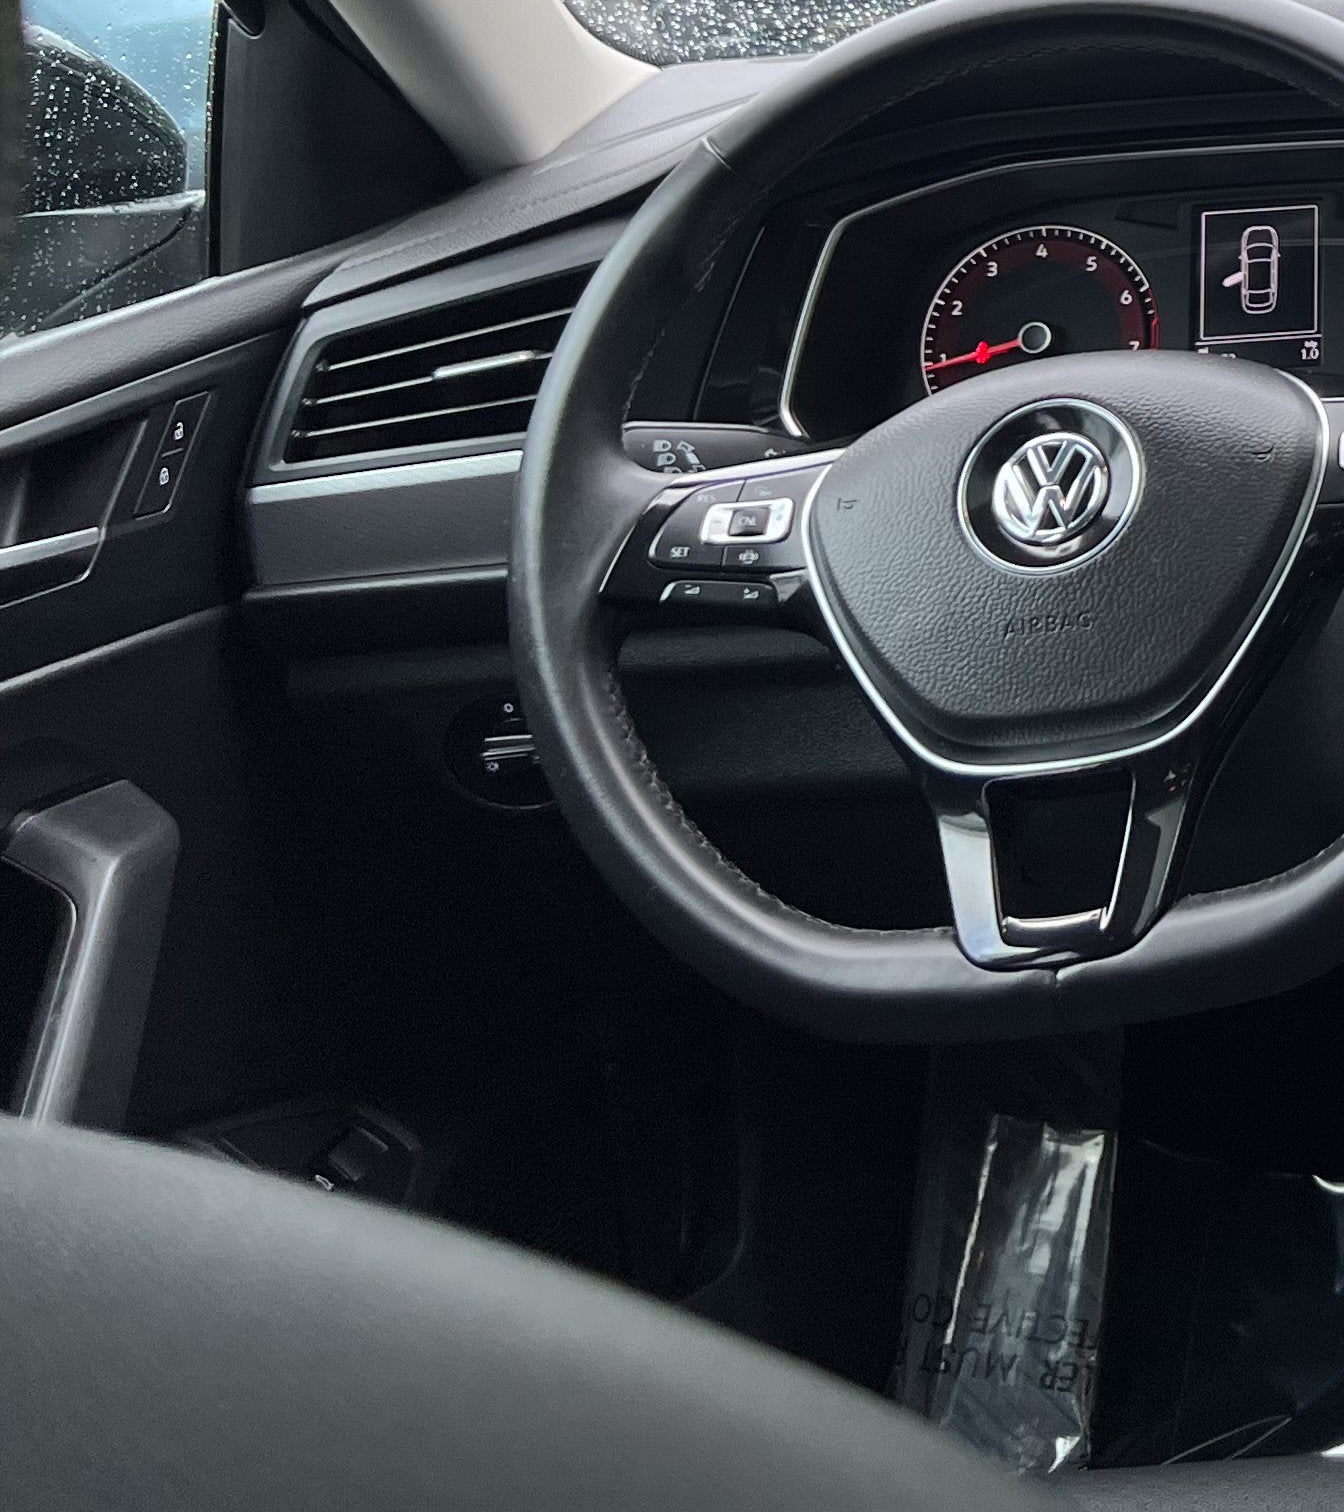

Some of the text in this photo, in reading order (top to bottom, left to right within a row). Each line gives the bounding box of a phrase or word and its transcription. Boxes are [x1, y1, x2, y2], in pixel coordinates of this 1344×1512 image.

[1035, 243, 1049, 259] 4
[986, 261, 998, 277] 3
[1085, 255, 1098, 272] 5
[1120, 289, 1133, 305] 6
[951, 300, 963, 316] 2
[670, 546, 690, 558] SET
[1003, 610, 1094, 641] AIRBAG
